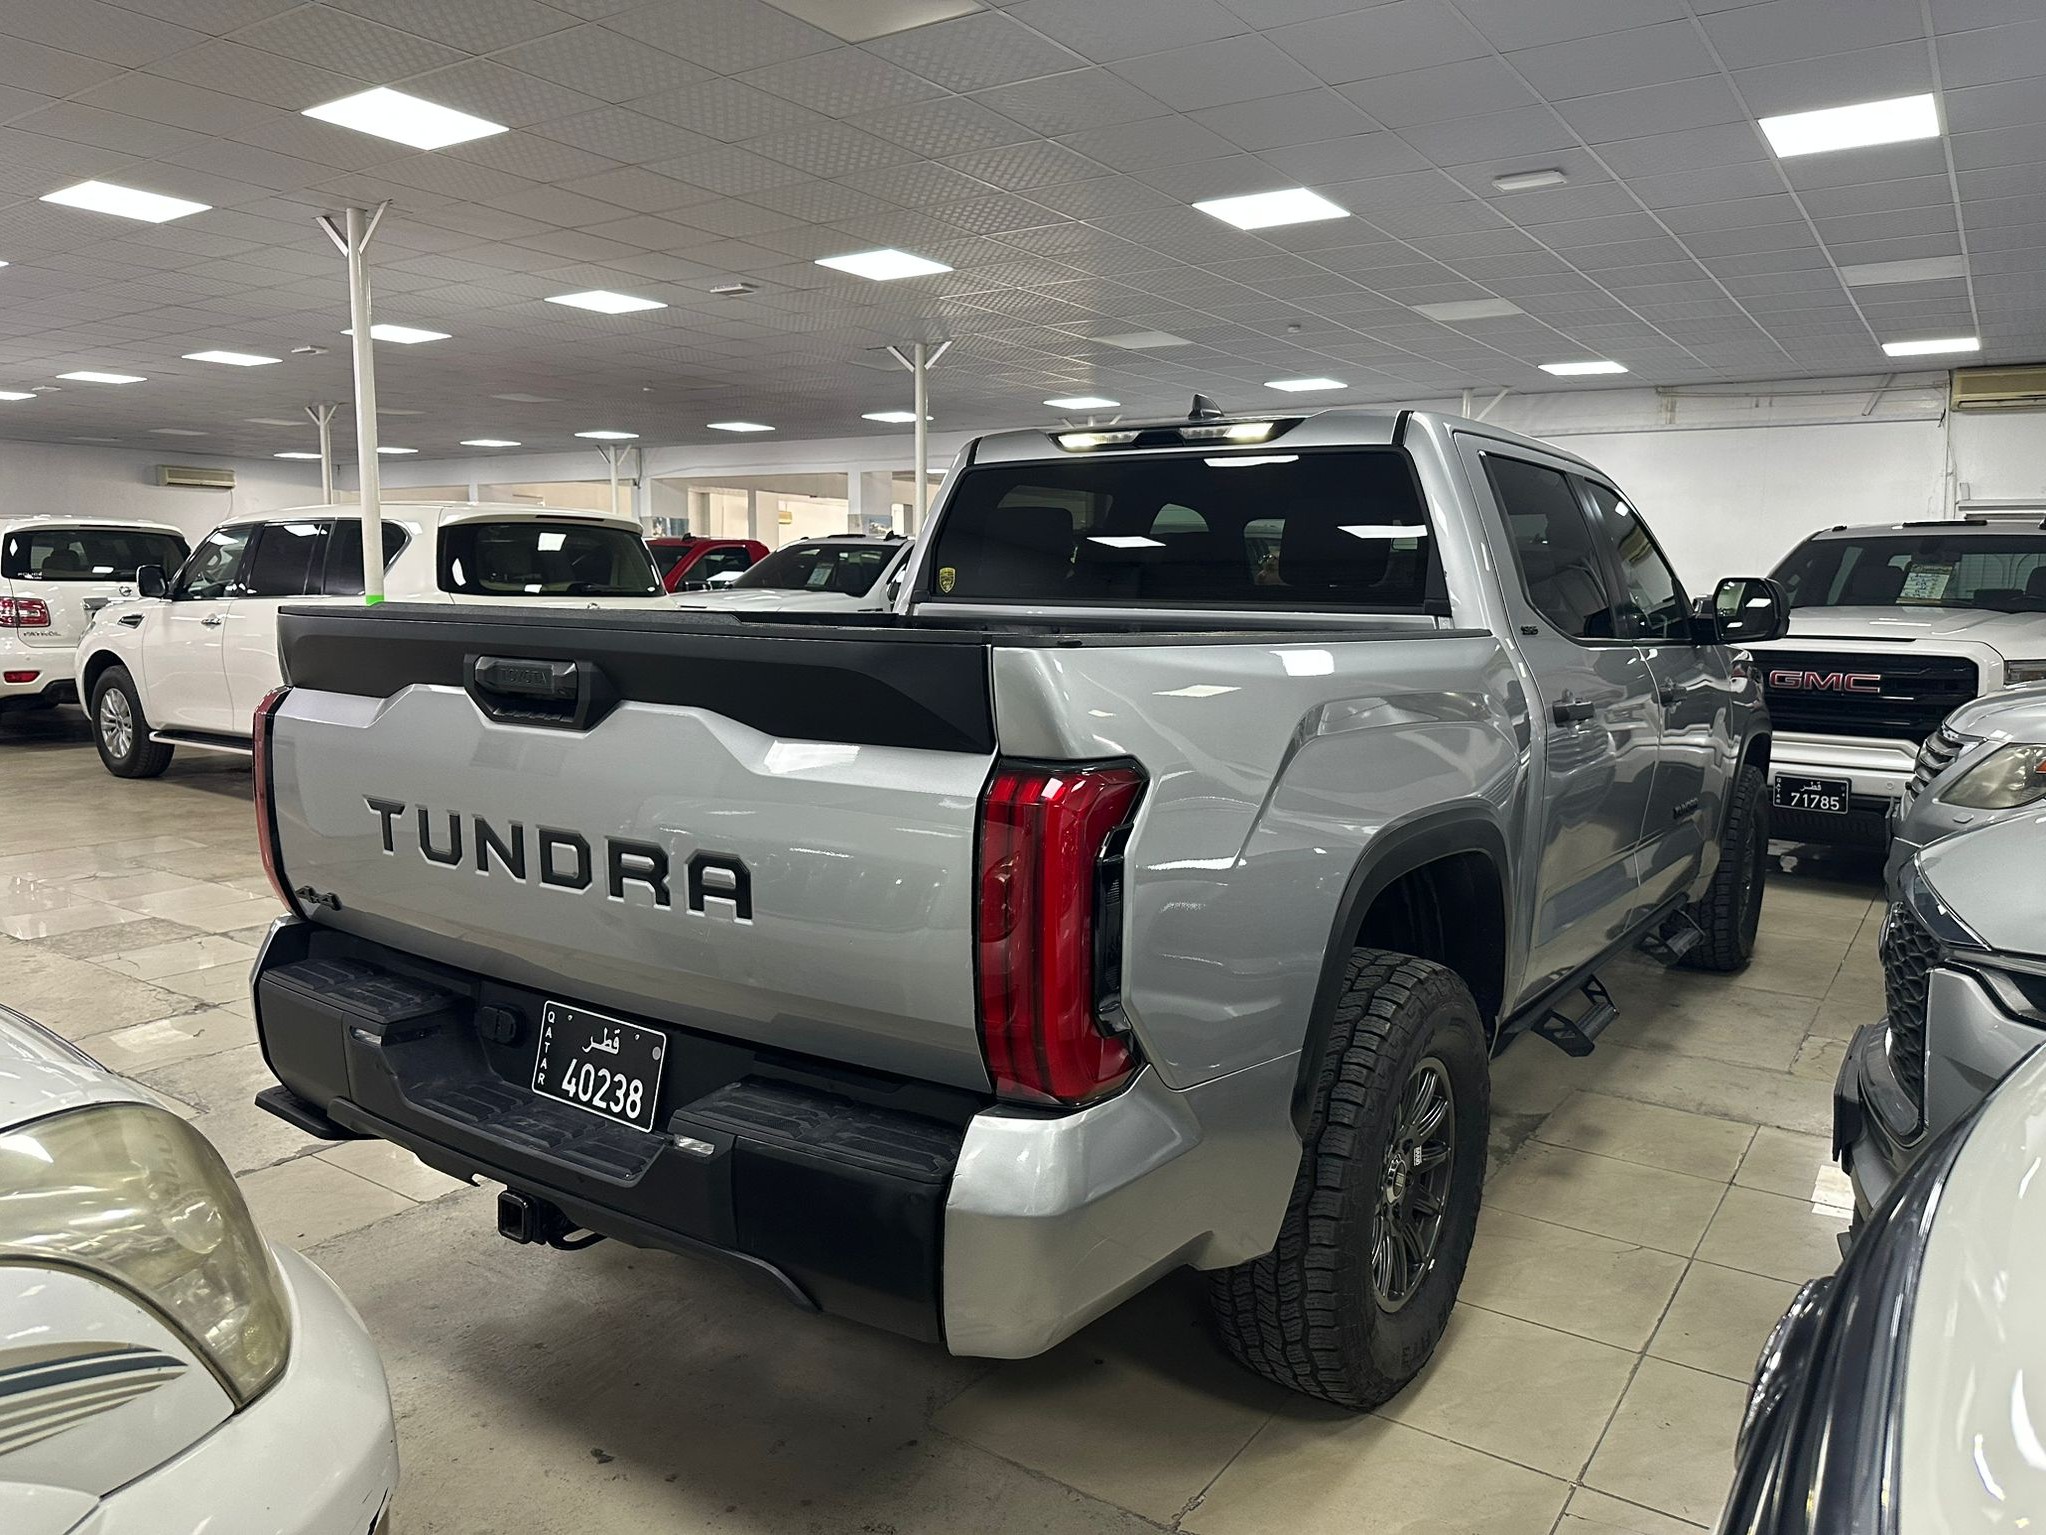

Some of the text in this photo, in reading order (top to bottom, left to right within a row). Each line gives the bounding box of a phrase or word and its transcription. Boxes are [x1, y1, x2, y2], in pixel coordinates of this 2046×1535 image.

[1769, 670, 1881, 693] GMC
[1800, 781, 1822, 792] قطر
[1790, 792, 1840, 811] 71785
[363, 794, 753, 925] TUNDRA
[537, 1010, 556, 1086] QATAR
[581, 1026, 622, 1055] قطر
[561, 1058, 644, 1119] 40238
